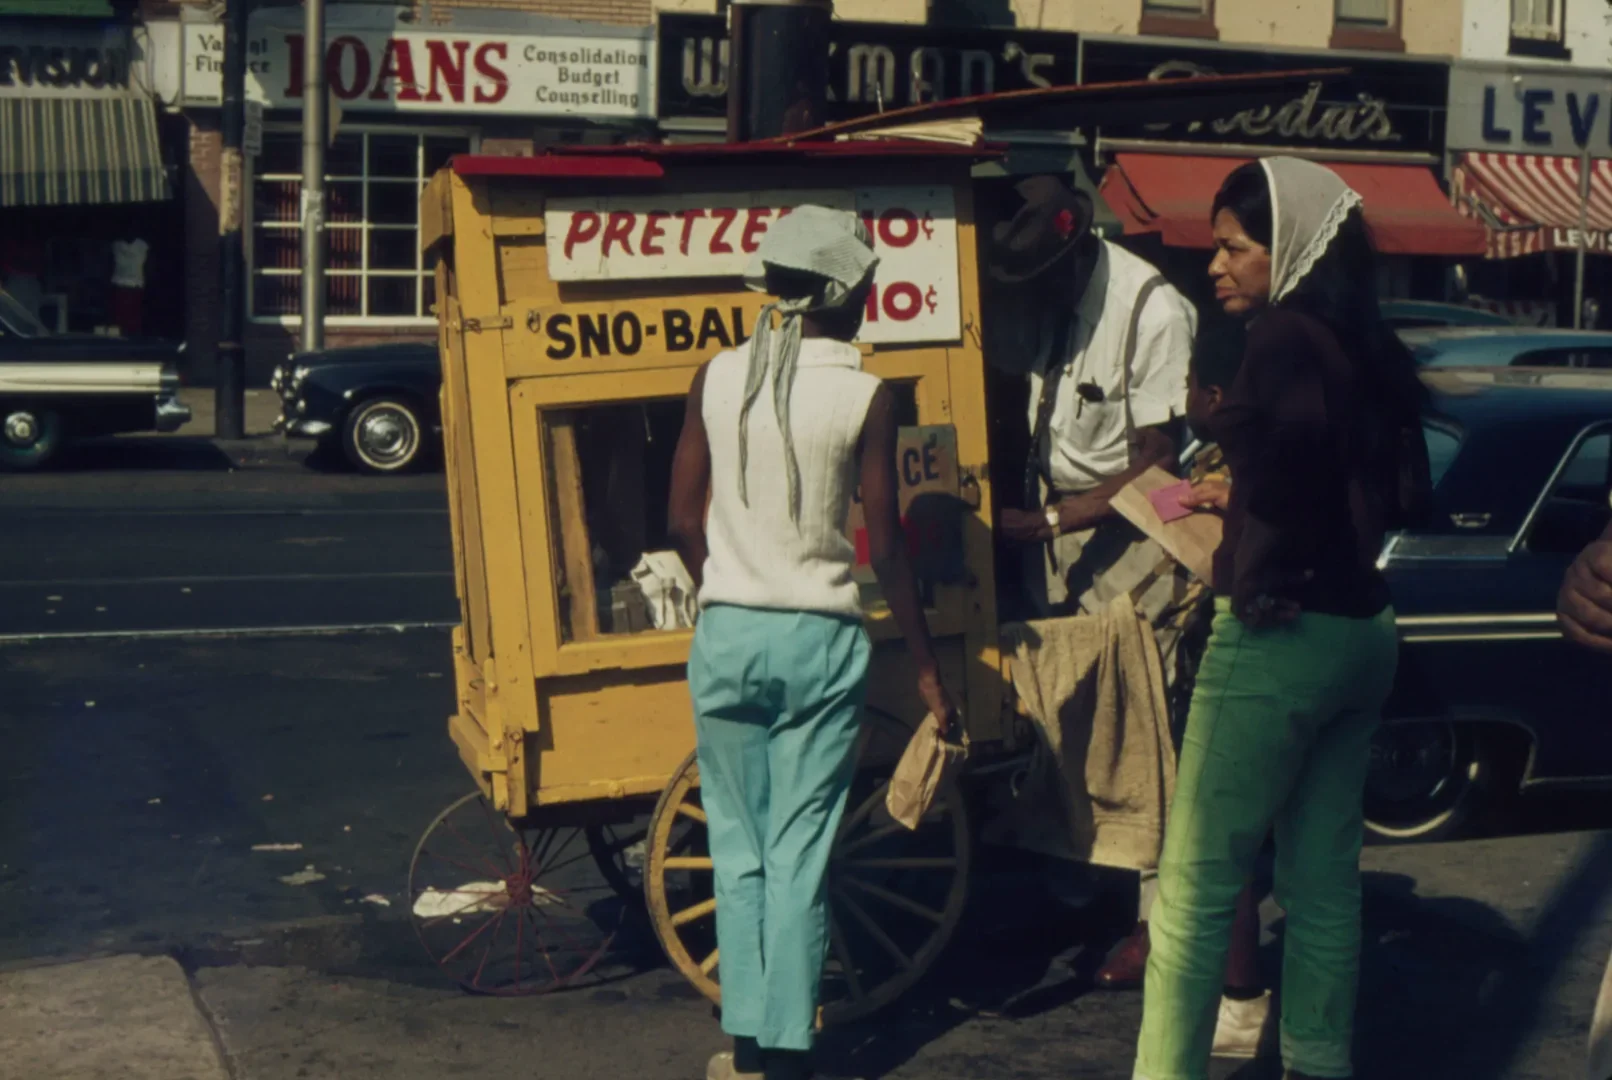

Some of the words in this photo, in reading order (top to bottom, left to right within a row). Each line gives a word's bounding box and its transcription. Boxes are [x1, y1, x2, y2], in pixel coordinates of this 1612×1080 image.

[196, 54, 271, 74] Fince
[523, 44, 648, 68] Consolidation
[557, 66, 620, 87] Budget
[535, 85, 640, 109] Counselling
[1482, 85, 1612, 150] LEV
[564, 207, 793, 260] PRETZE
[545, 304, 775, 360] SNO-BAL
